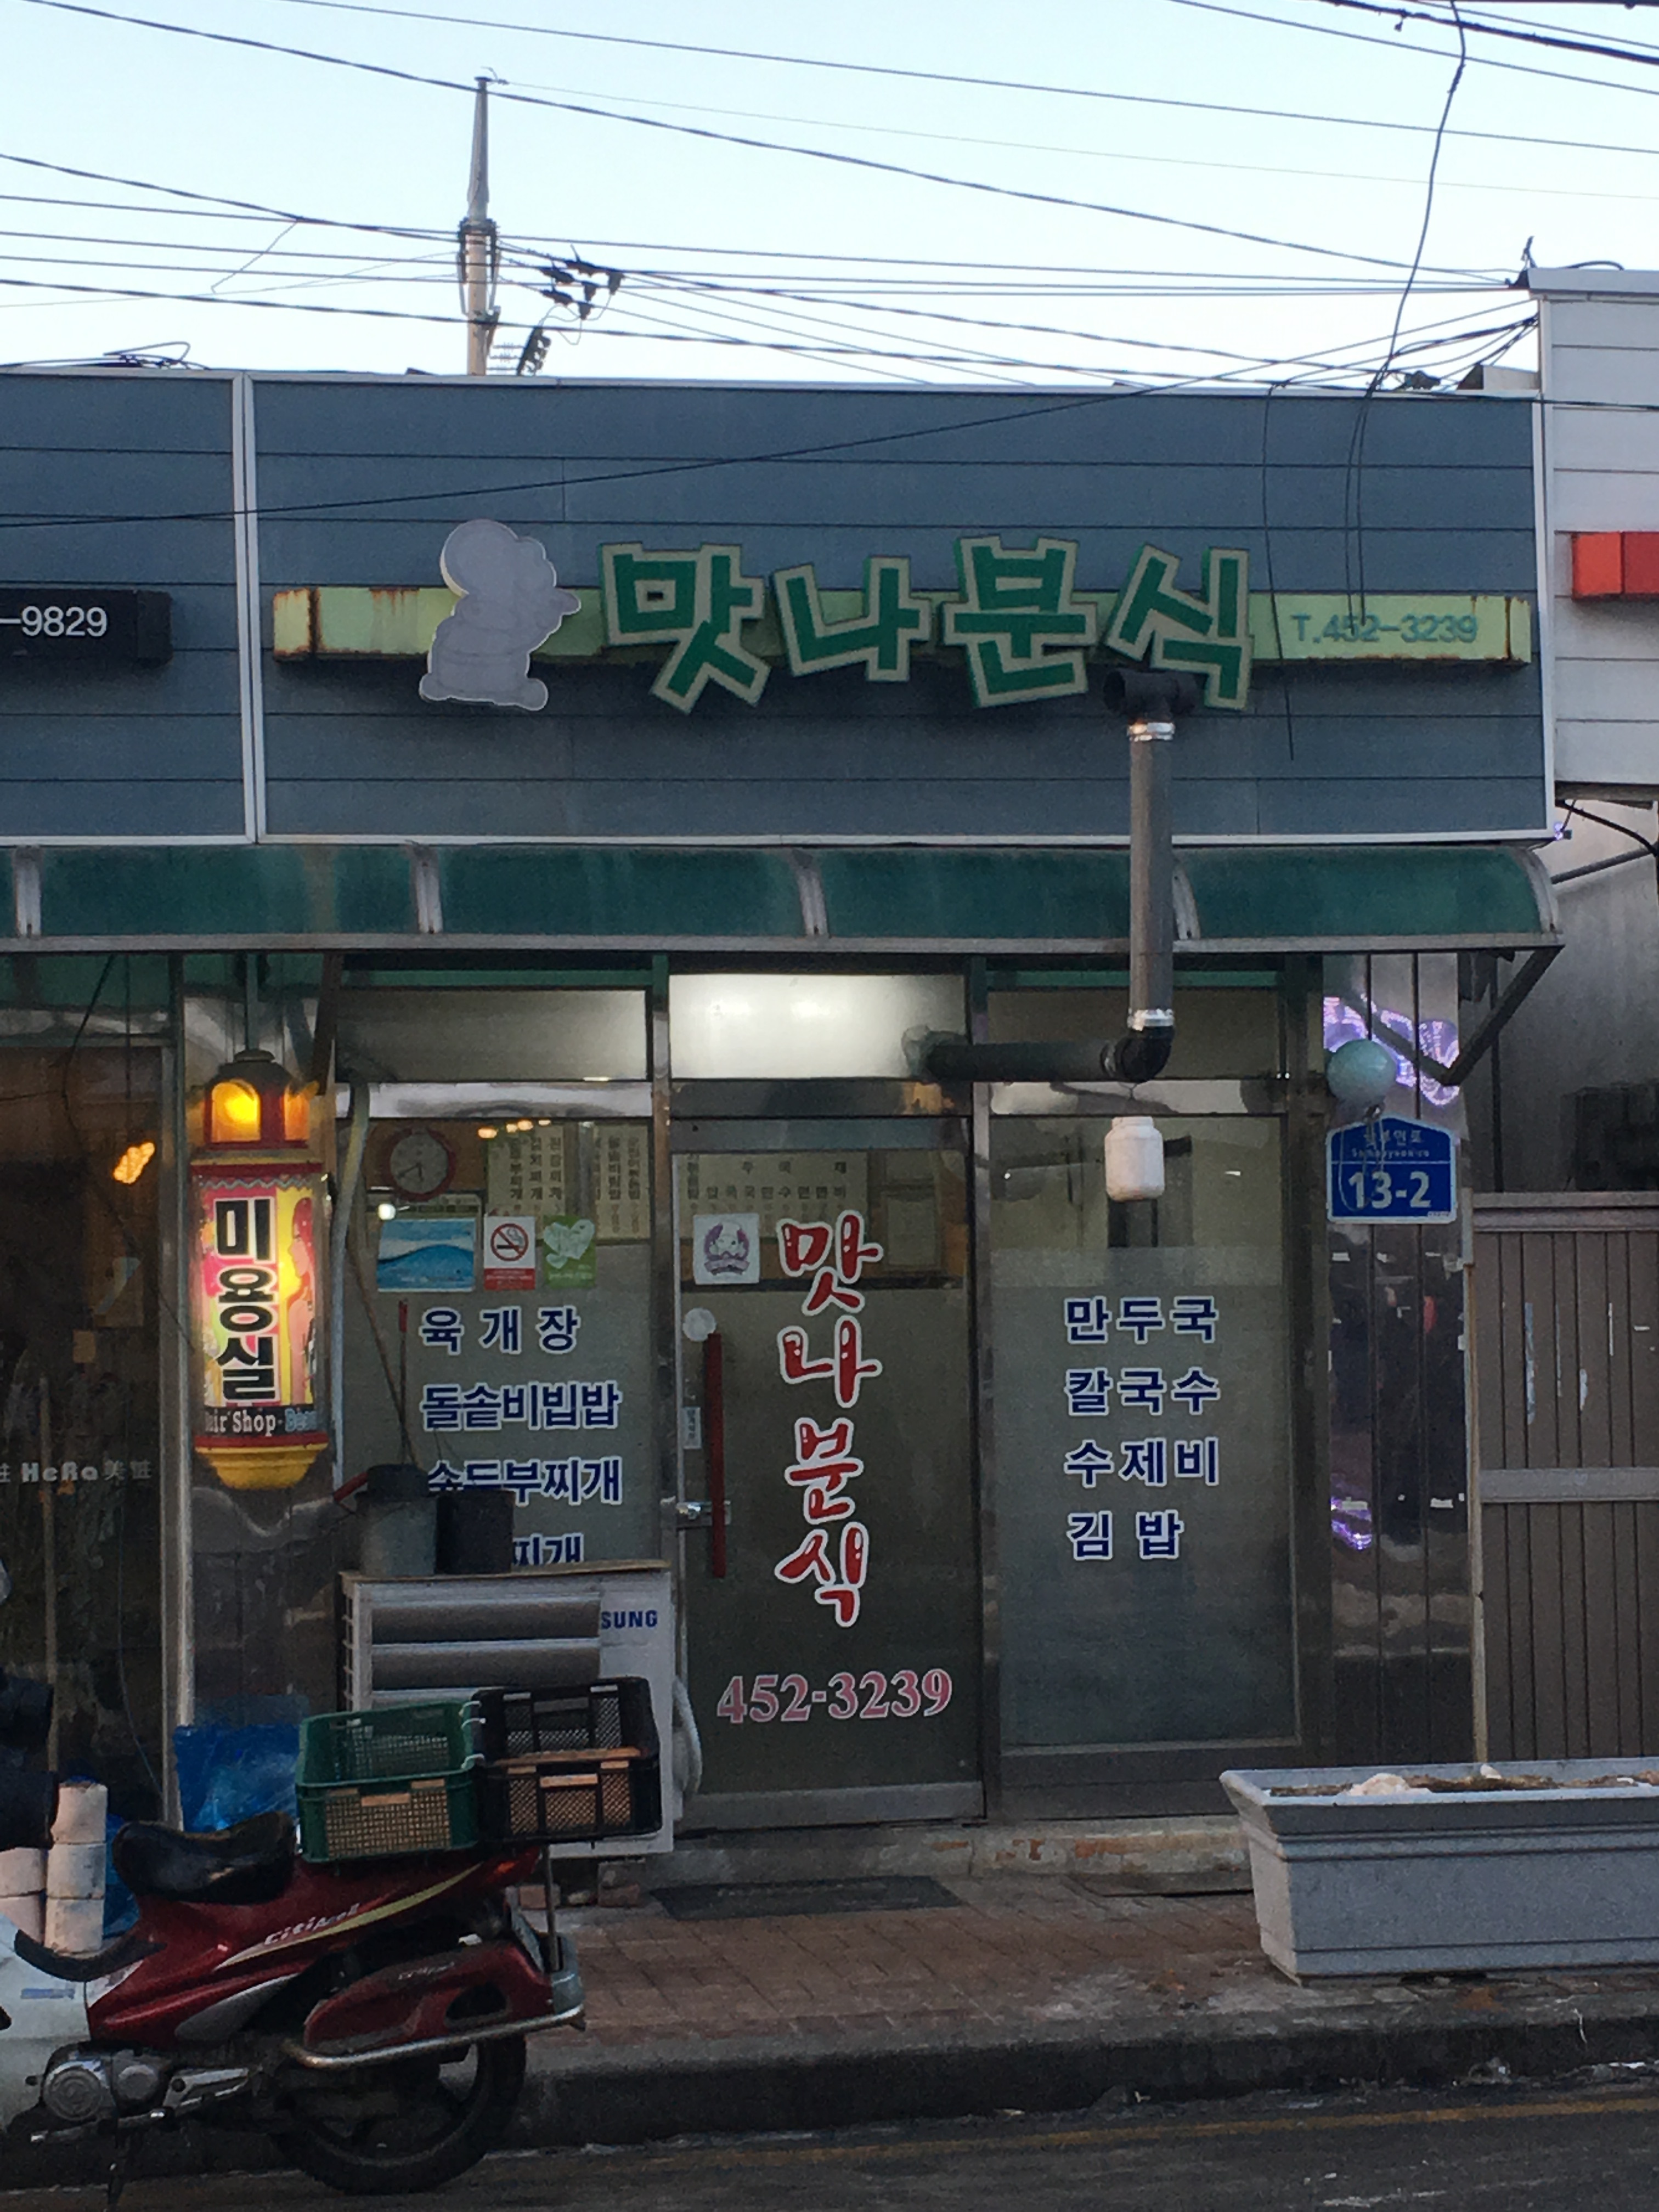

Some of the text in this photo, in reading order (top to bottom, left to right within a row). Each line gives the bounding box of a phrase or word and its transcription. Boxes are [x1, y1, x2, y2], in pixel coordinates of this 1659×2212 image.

[601, 535, 1254, 714] 맛나분식
[1291, 613, 1477, 643] T.452-3239
[1348, 1171, 1432, 1209] 13-2
[215, 1197, 278, 1403] 미용실
[1064, 1296, 1219, 1344] 만두국
[1064, 1367, 1220, 1415] 칼국수
[233, 1408, 276, 1436] Shop
[776, 1210, 883, 1627] 맛나분식
[1064, 1437, 1220, 1488] 수제비
[716, 1668, 952, 1724] 452-3239
